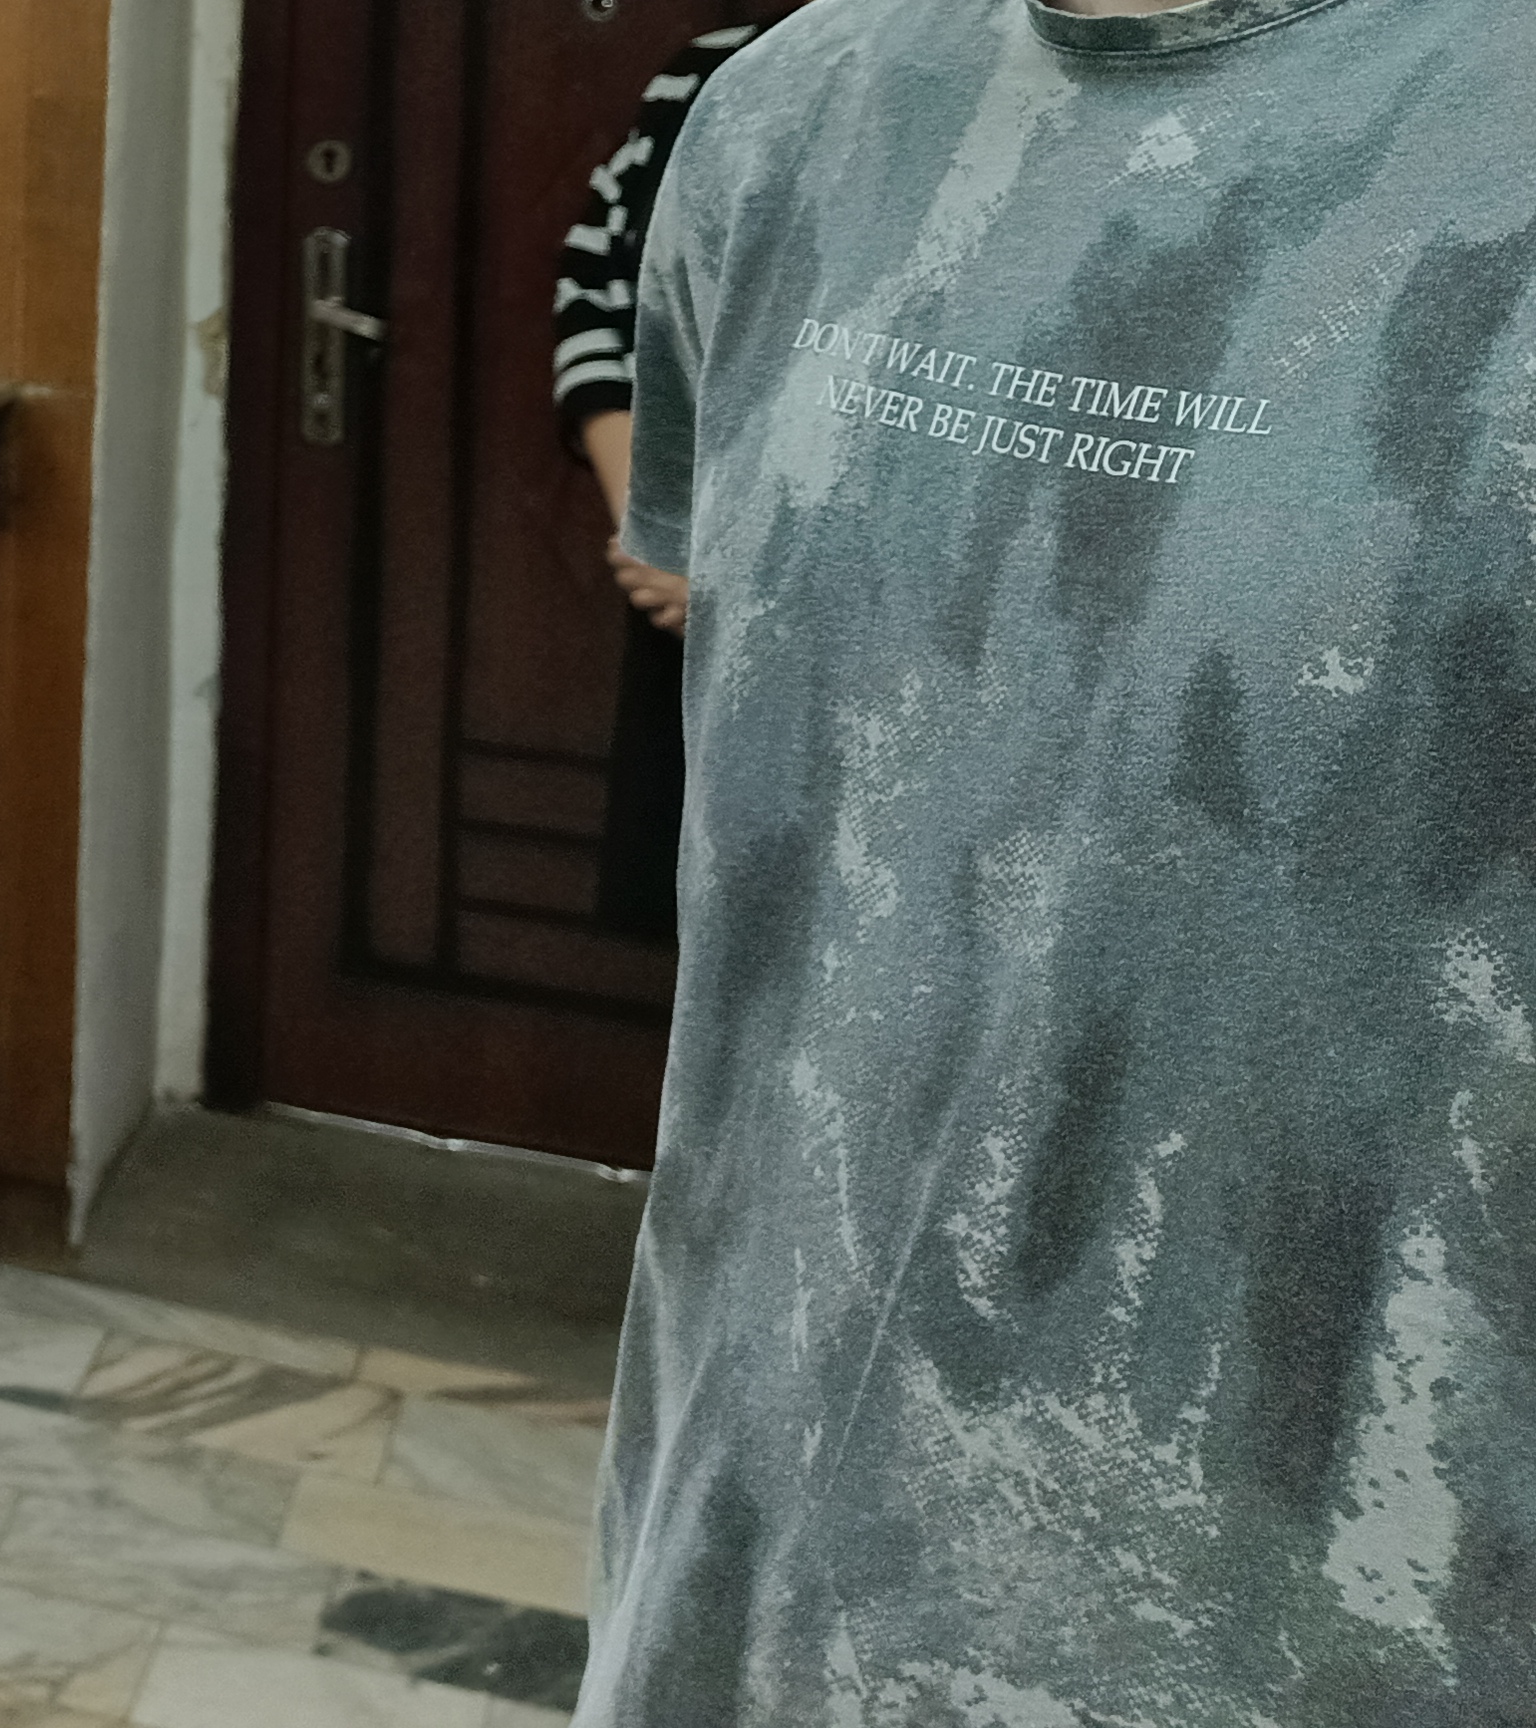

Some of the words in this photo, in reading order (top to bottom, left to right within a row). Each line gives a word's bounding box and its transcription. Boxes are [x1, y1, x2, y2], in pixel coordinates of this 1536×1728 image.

[817, 375, 923, 433] NEVER
[927, 404, 977, 445] BE
[972, 417, 1064, 465] JUST
[1065, 433, 1195, 485] RIGHT
[986, 362, 1065, 408] THE
[1068, 376, 1168, 424] TIME
[1172, 390, 1275, 436] WILL
